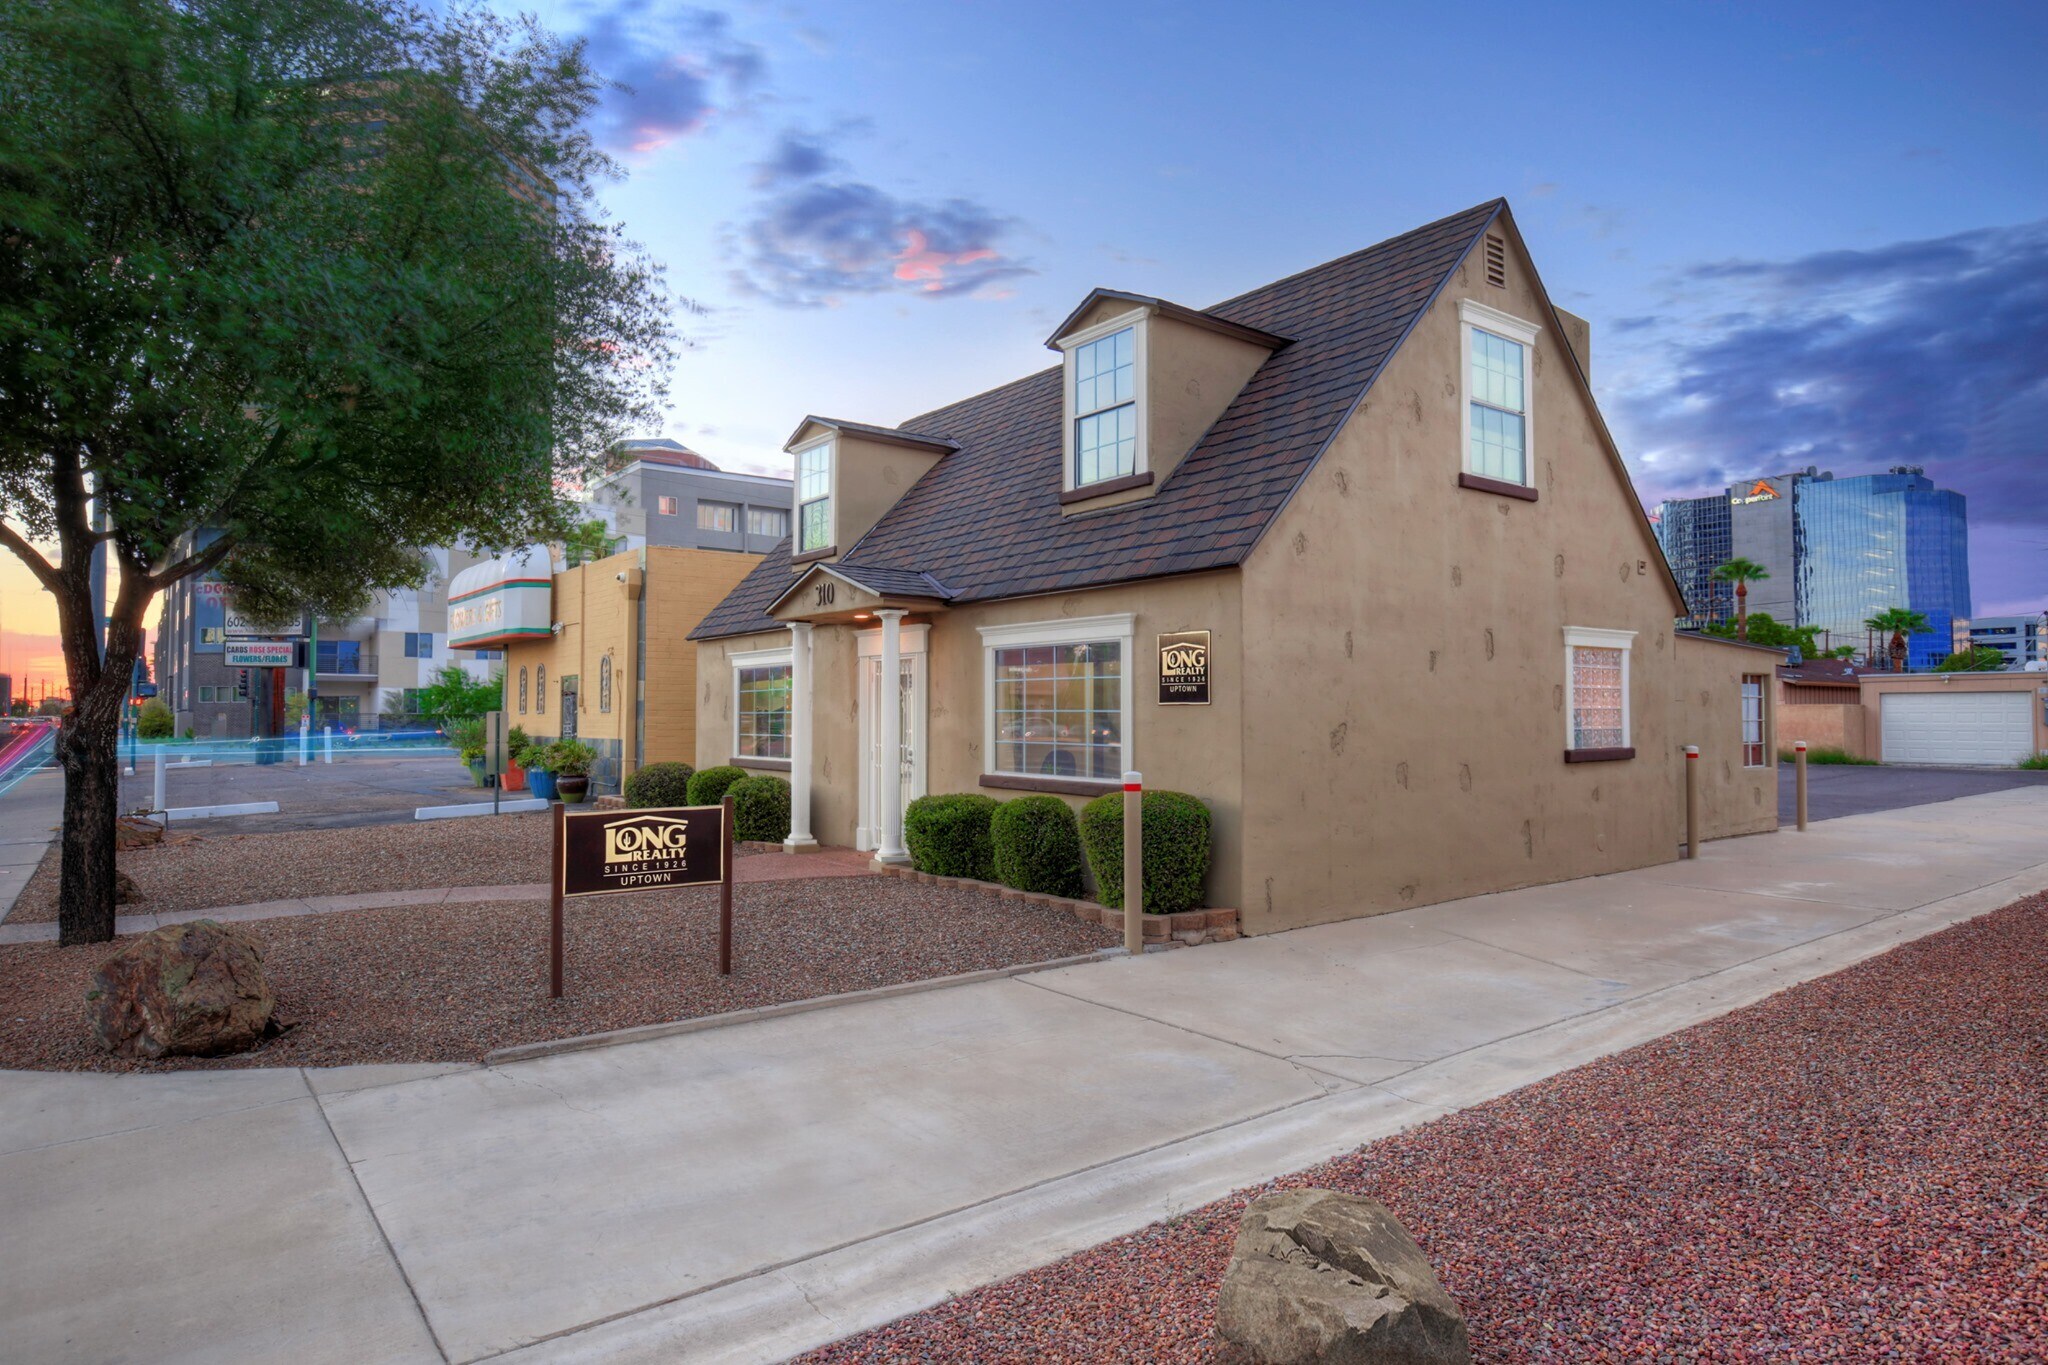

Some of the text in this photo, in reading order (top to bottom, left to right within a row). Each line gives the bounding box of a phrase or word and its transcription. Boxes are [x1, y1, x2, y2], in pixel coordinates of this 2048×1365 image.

[815, 582, 835, 606] 310
[227, 645, 293, 654] CARDS ROSE SPECIAL
[1162, 649, 1205, 675] LONG
[1176, 667, 1205, 675] REALTY
[1169, 685, 1197, 693] UPTOWN
[605, 824, 687, 863] LONG
[632, 847, 687, 861] REALTY
[604, 860, 687, 874] SINCE 1926
[620, 873, 671, 886] UPTOWN
